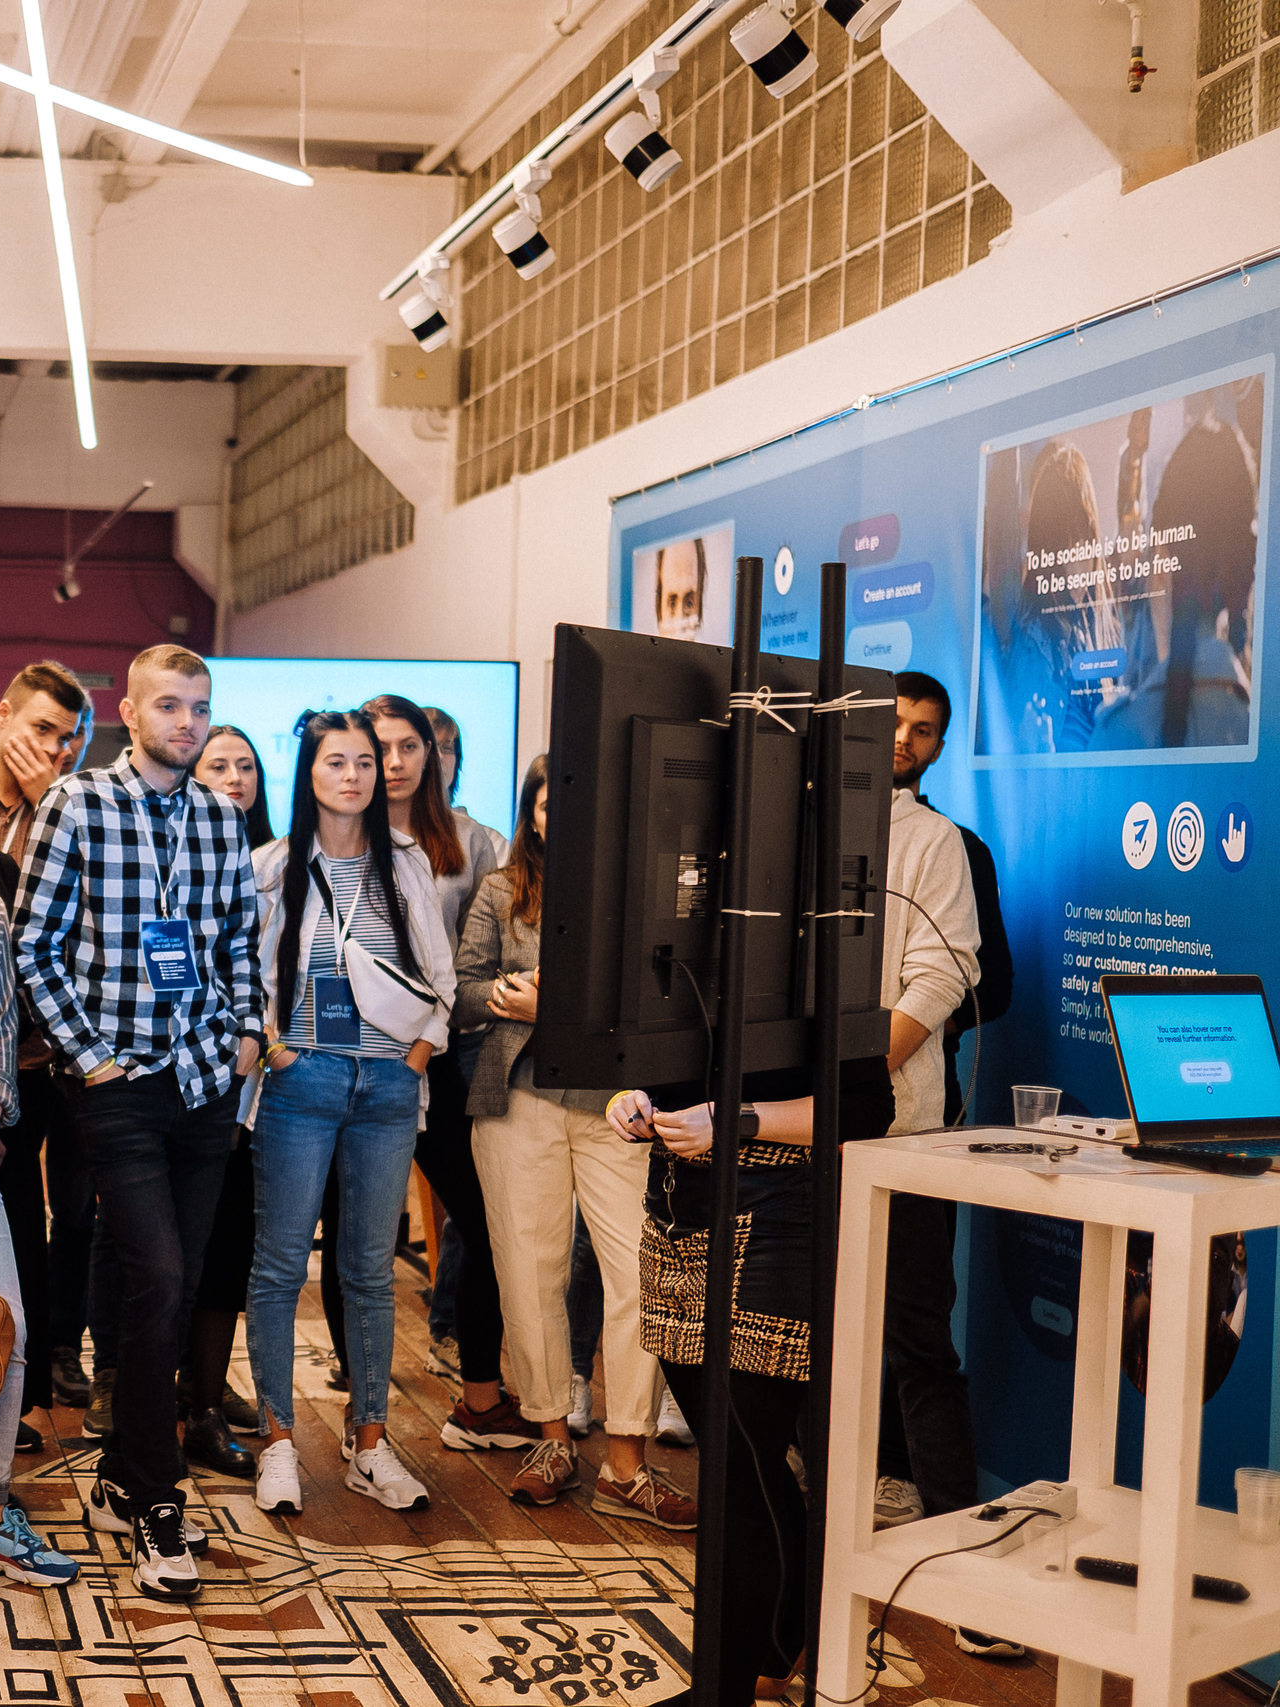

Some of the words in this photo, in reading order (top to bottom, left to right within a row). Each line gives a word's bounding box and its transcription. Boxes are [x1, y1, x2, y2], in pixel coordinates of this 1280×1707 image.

[1026, 551, 1040, 571] To
[1040, 549, 1054, 568] be
[1056, 538, 1103, 566] sociable
[1104, 535, 1114, 557] is
[1116, 535, 1129, 554] to
[1131, 530, 1147, 549] be
[1149, 523, 1197, 548] human.
[1035, 575, 1049, 595] To
[1050, 573, 1066, 593] be
[1066, 567, 1105, 590] secure
[1106, 563, 1117, 583] is
[1119, 562, 1132, 581] to
[1134, 557, 1150, 579] be
[1152, 553, 1182, 575] free.
[863, 588, 885, 603] Create
[885, 587, 895, 601] an
[895, 581, 921, 599] account
[1065, 901, 1082, 918] Our
[1084, 907, 1103, 921] new
[1105, 905, 1142, 924] solution
[1145, 908, 1162, 926] has
[1165, 909, 1191, 928] been
[1064, 926, 1105, 948] designed
[1106, 931, 1116, 947] to
[1119, 931, 1132, 948] be
[1134, 936, 1214, 959] comprehensive,
[1063, 953, 1073, 965] so
[1076, 954, 1092, 968] our
[1094, 956, 1147, 975] customers
[1149, 963, 1168, 976] can
[1062, 975, 1090, 996] safely
[326, 1003, 342, 1011] Let's
[1094, 1002, 1101, 1018] it
[1060, 1021, 1070, 1037] of
[1072, 1023, 1086, 1040] the
[1157, 1025, 1168, 1033] You
[1181, 1025, 1192, 1033] also
